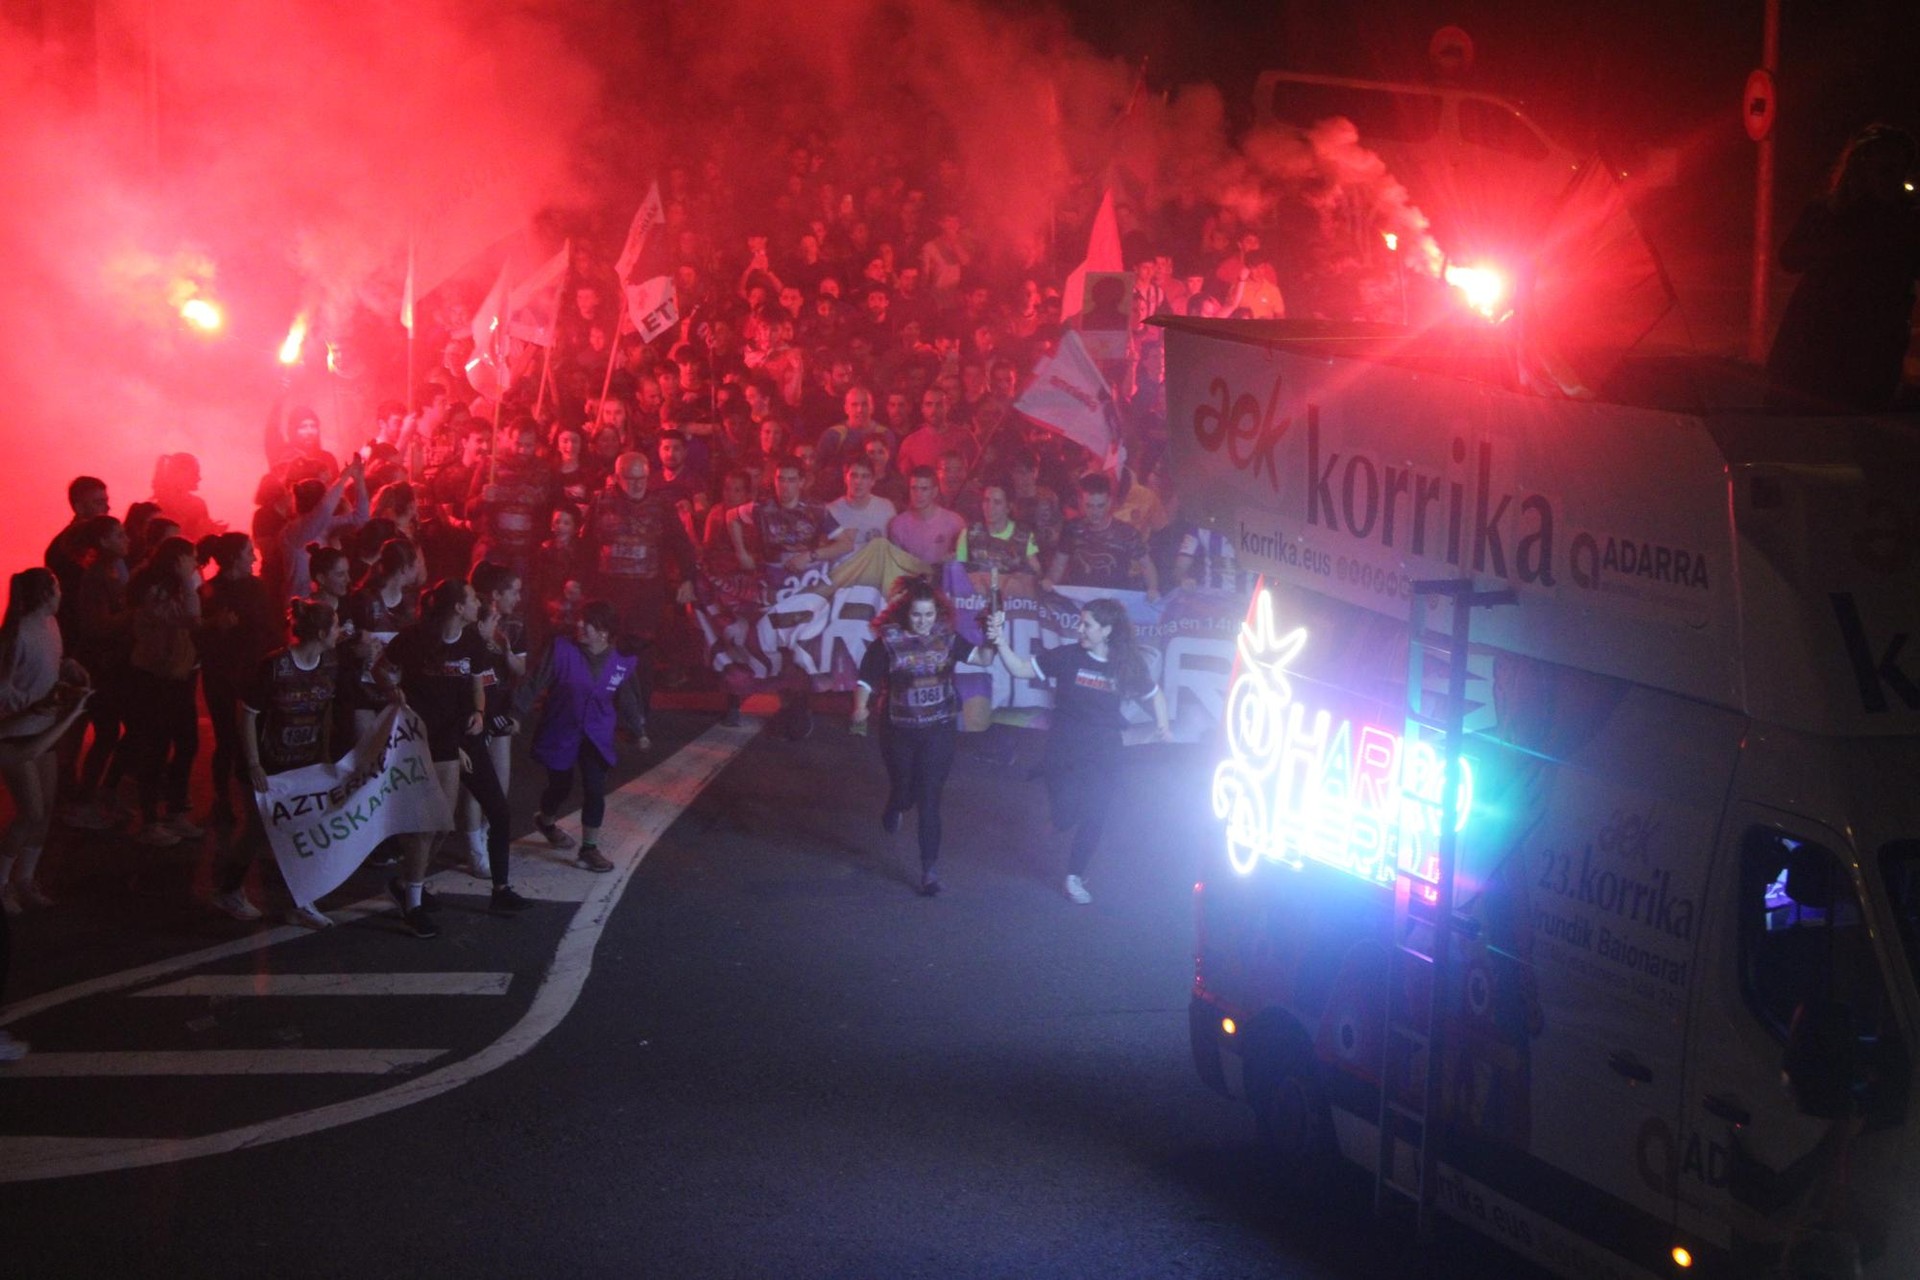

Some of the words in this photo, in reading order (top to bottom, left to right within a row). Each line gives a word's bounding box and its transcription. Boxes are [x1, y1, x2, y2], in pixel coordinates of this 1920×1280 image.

[1194, 376, 1291, 492] aek
[1240, 521, 1330, 577] korrika.eus
[1307, 402, 1556, 588] korrika
